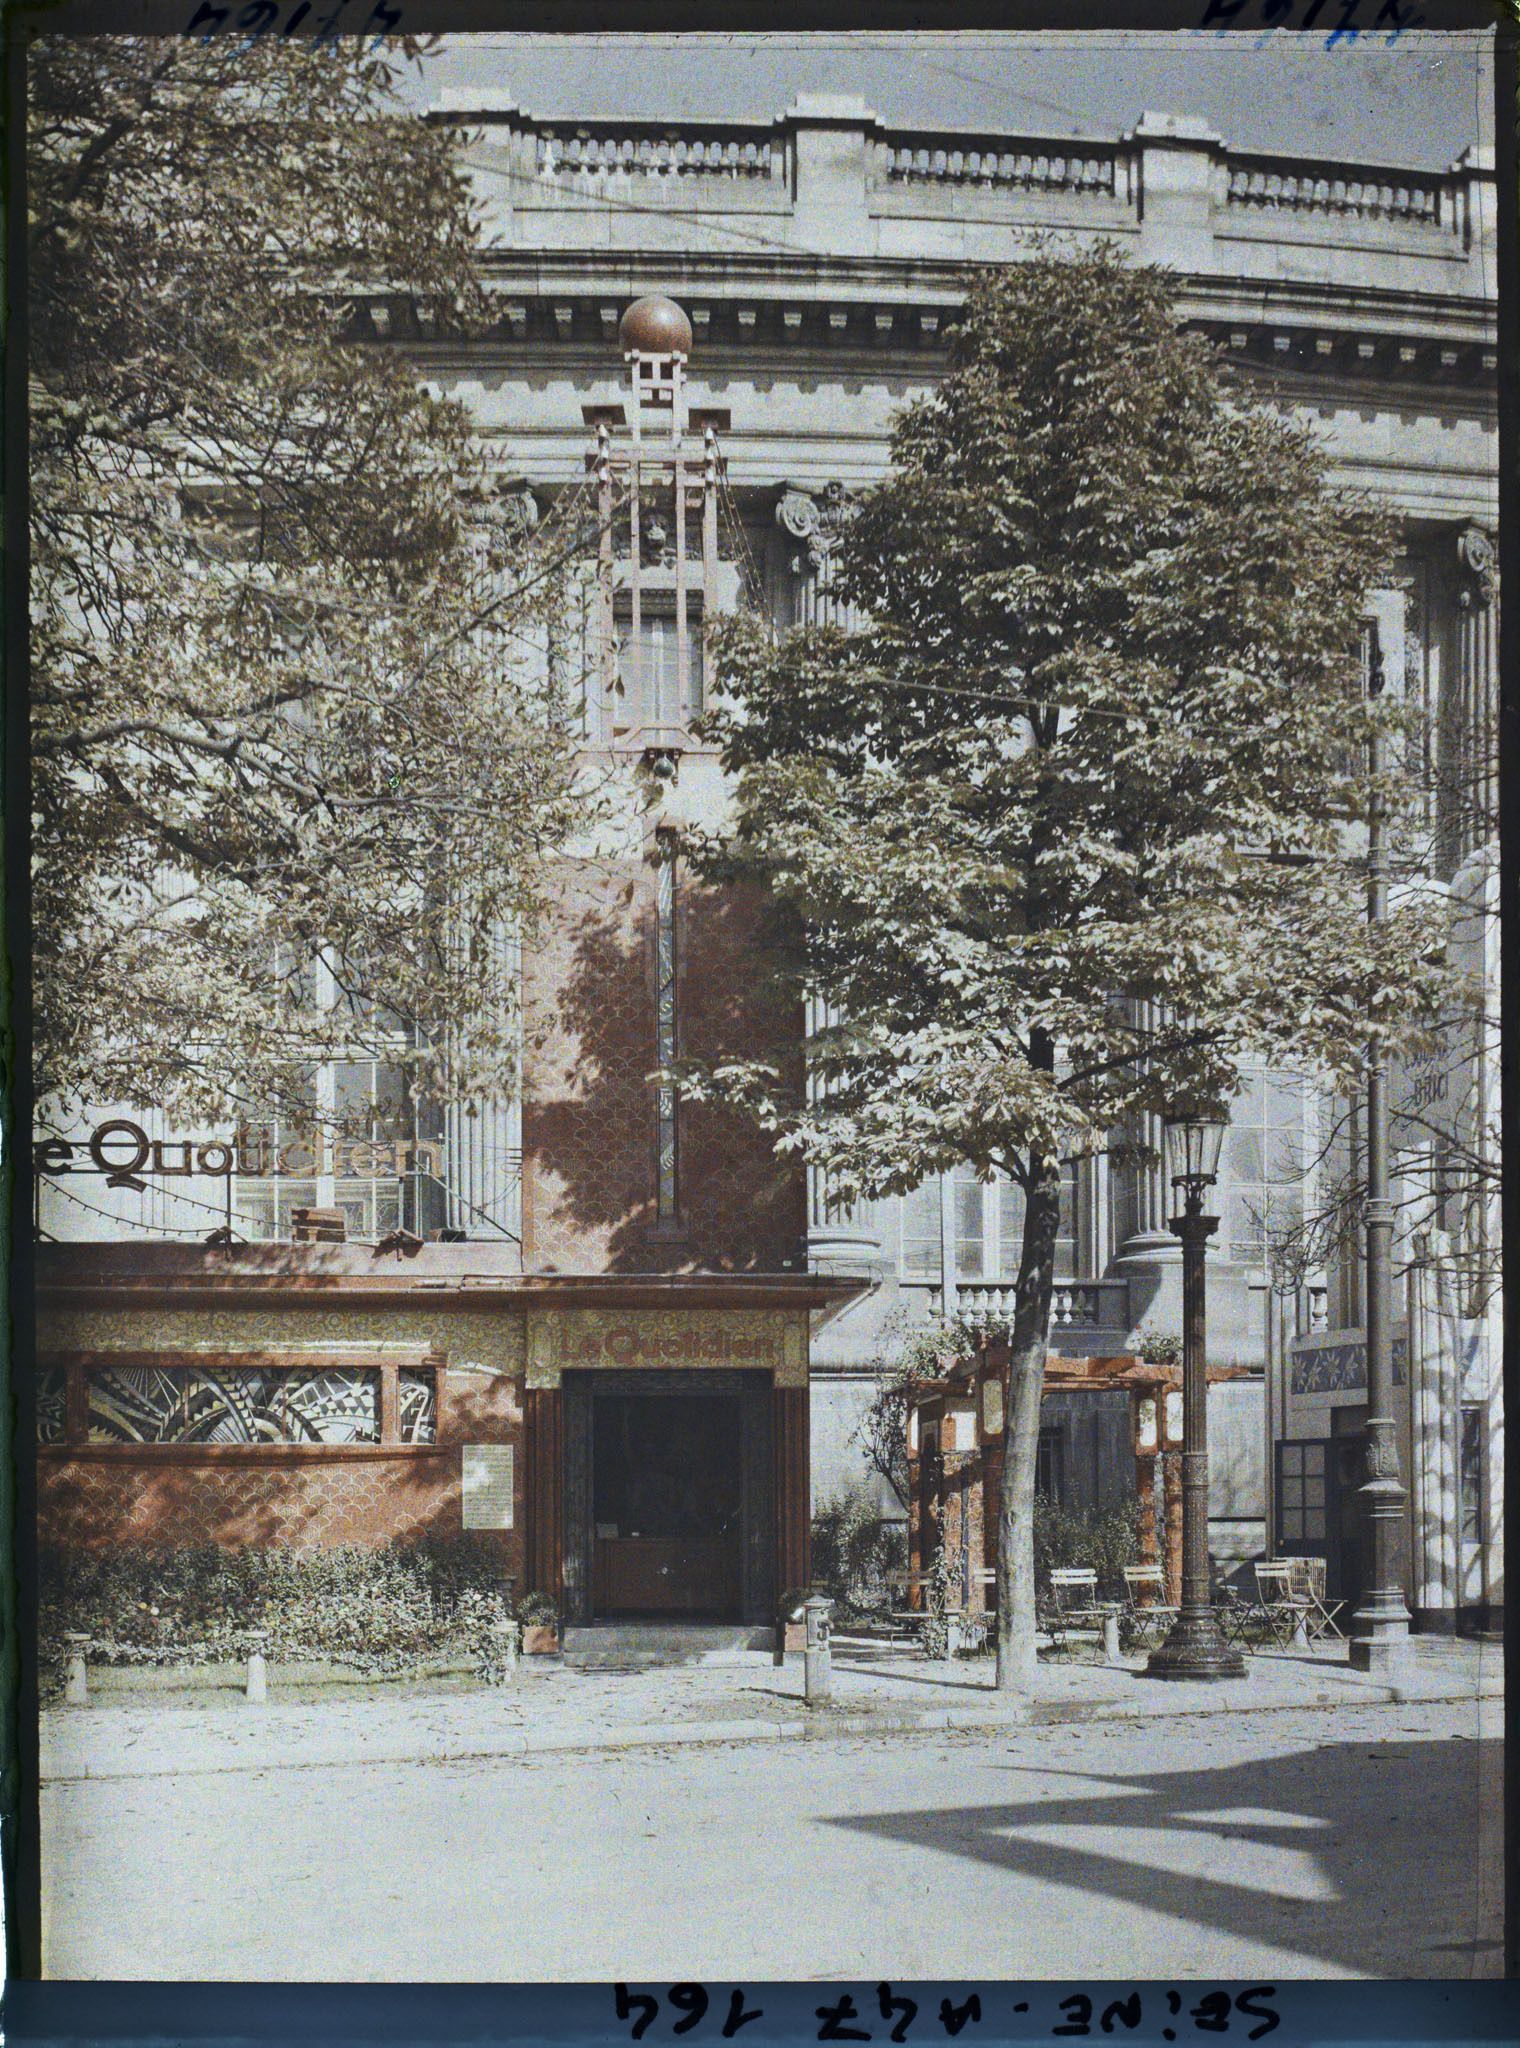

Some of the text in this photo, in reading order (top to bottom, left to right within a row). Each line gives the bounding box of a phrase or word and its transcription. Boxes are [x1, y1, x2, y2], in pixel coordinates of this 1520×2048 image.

[89, 1119, 443, 1193] Quotidien
[562, 1328, 775, 1364] Le Quotidien
[615, 1981, 764, 2041] 164
